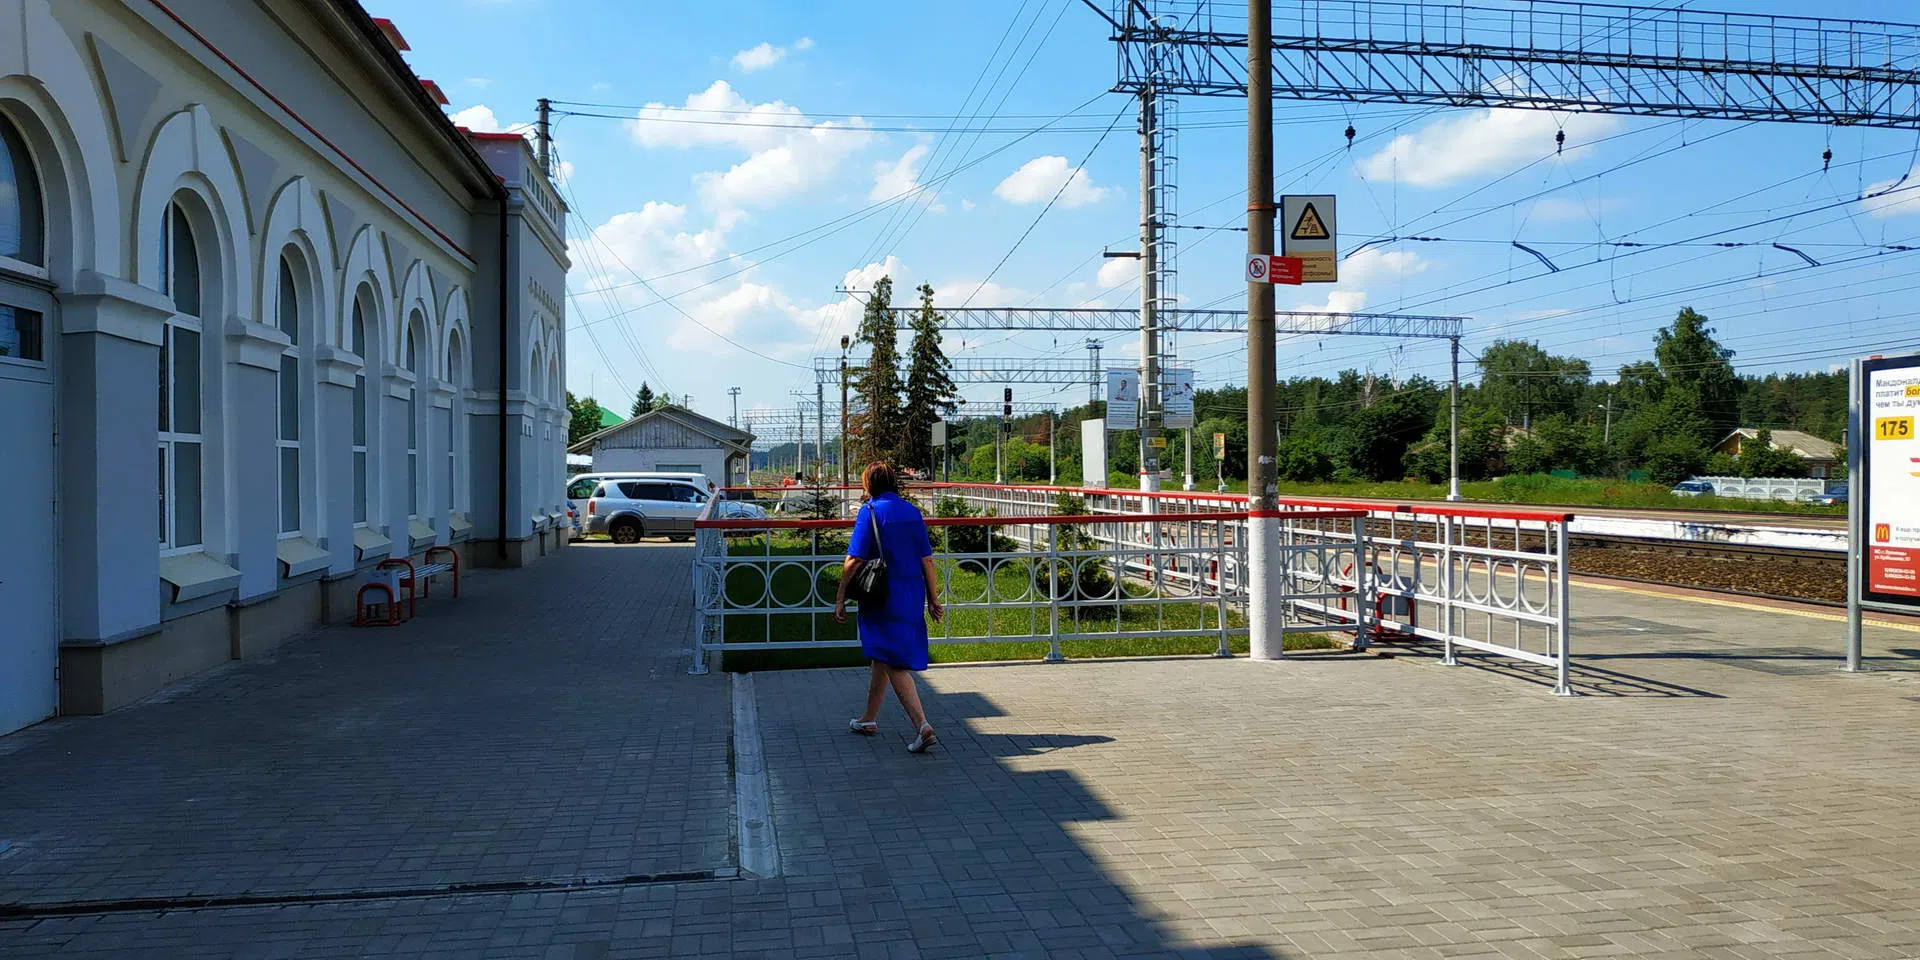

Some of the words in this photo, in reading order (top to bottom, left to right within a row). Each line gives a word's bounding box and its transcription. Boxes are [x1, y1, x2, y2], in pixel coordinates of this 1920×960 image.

[1876, 390, 1904, 398] платит
[1876, 401, 1890, 409] чем
[1880, 420, 1908, 436] 175
